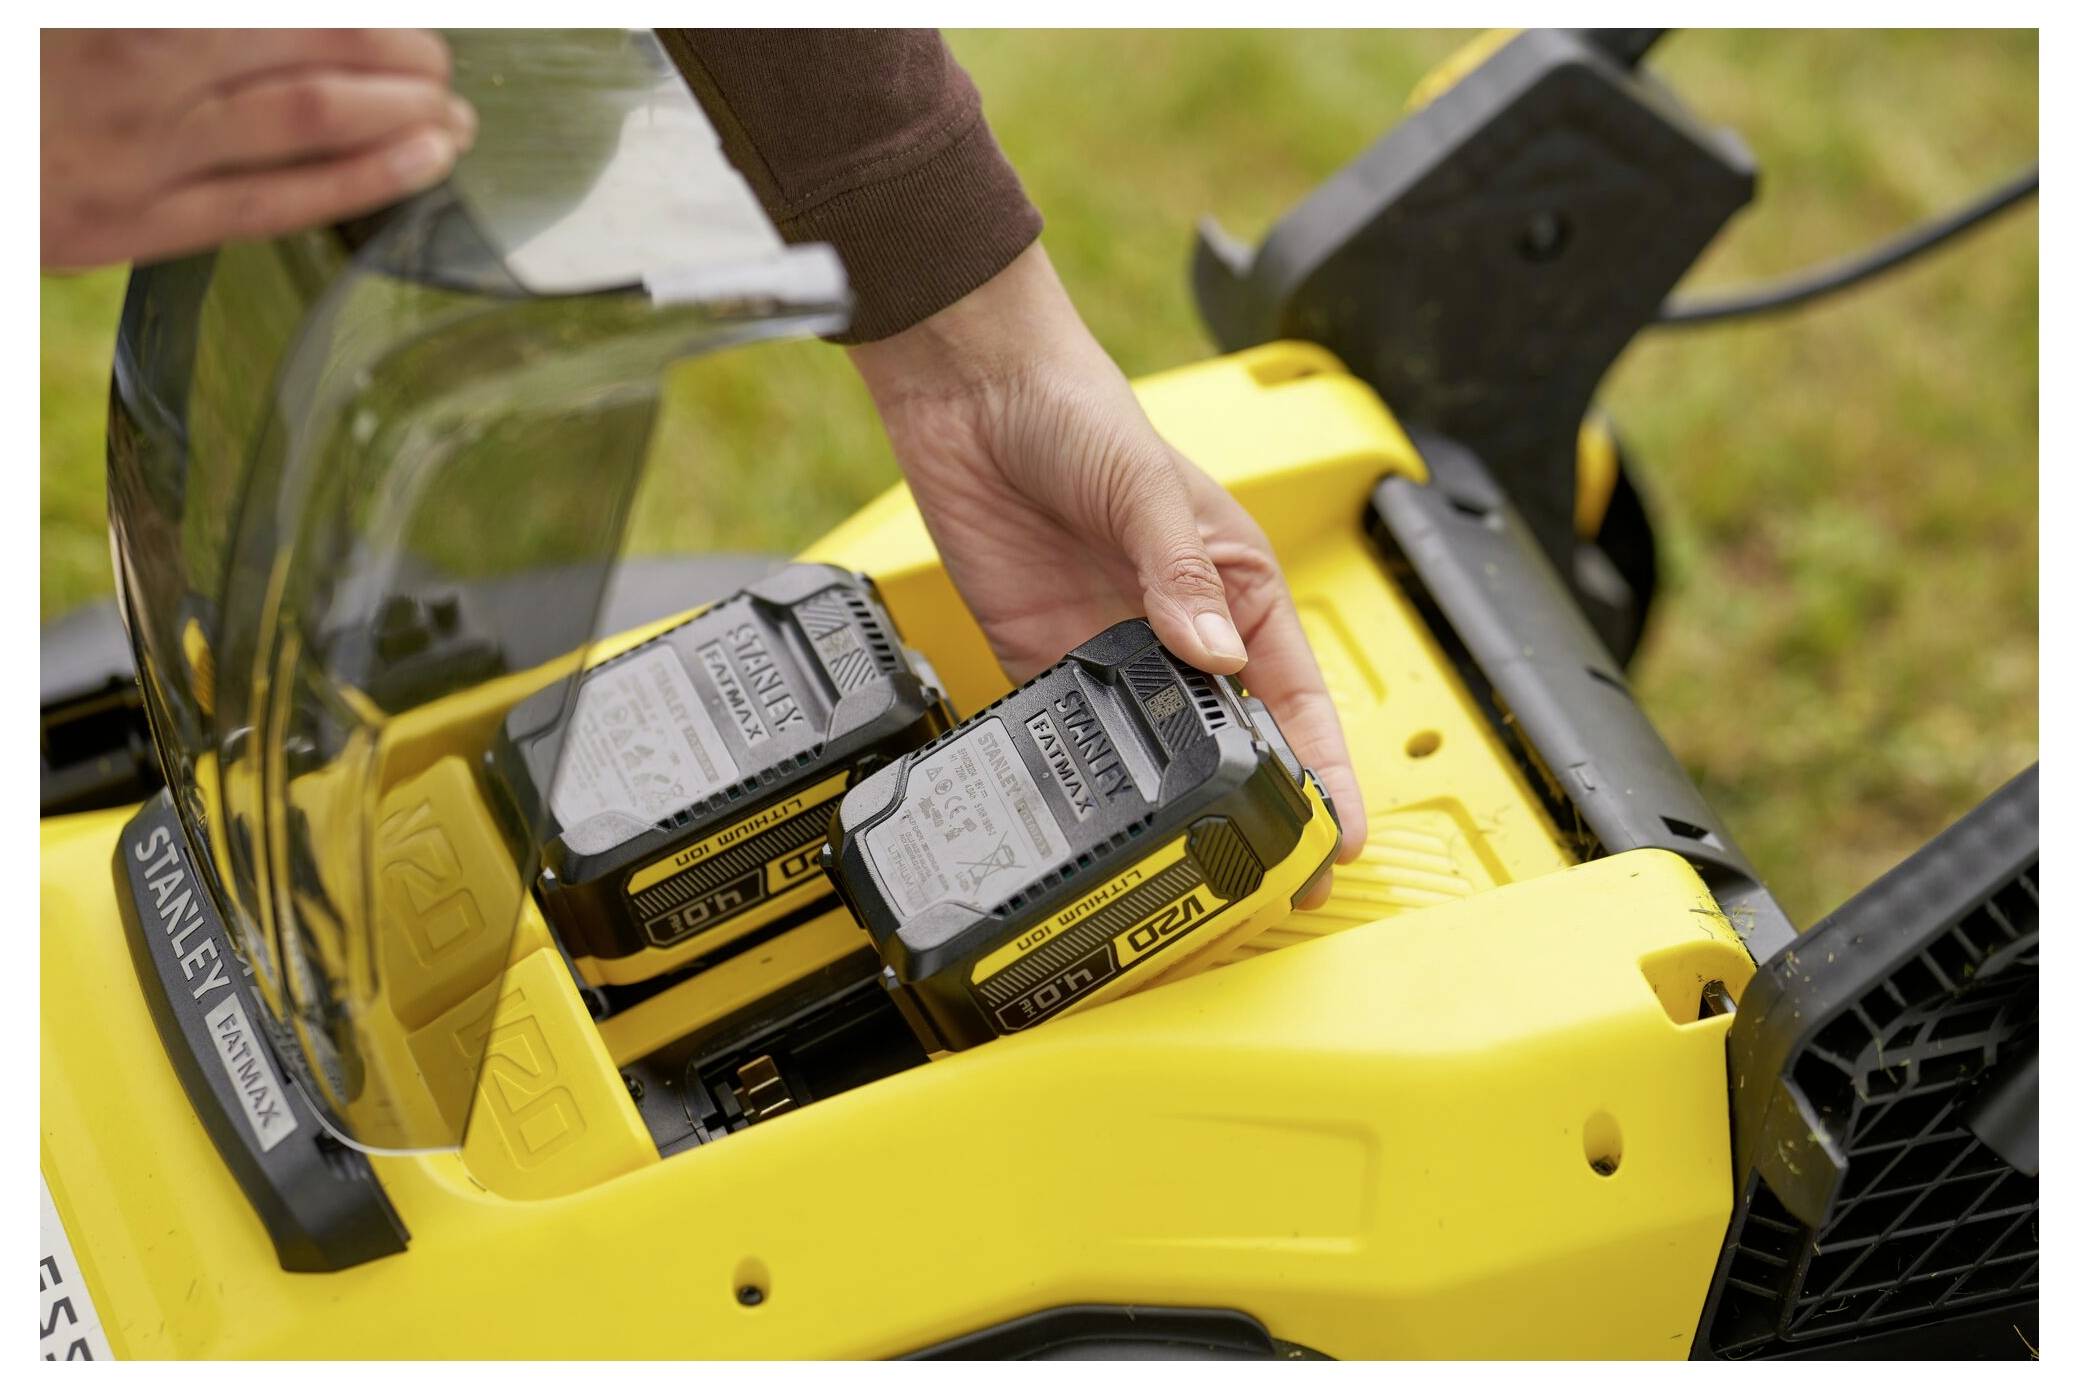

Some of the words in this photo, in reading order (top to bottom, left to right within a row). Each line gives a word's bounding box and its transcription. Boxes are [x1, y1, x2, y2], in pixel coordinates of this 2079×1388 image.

[705, 651, 762, 740] FATMAX
[727, 623, 803, 726] STANLEY
[978, 732, 1022, 796] STANLEY
[1033, 718, 1094, 814] FATMAX
[1054, 690, 1132, 797] STANLEY
[717, 798, 803, 847] LITHIUM
[675, 844, 710, 867] ION
[682, 890, 743, 927] 4.0
[1058, 870, 1142, 926] LITHIUM
[1127, 895, 1205, 953] V20
[1016, 925, 1052, 951] ION
[135, 826, 231, 1000] STANLEY
[217, 1012, 281, 1129] FATMAX
[1033, 967, 1094, 1009] 4.0
